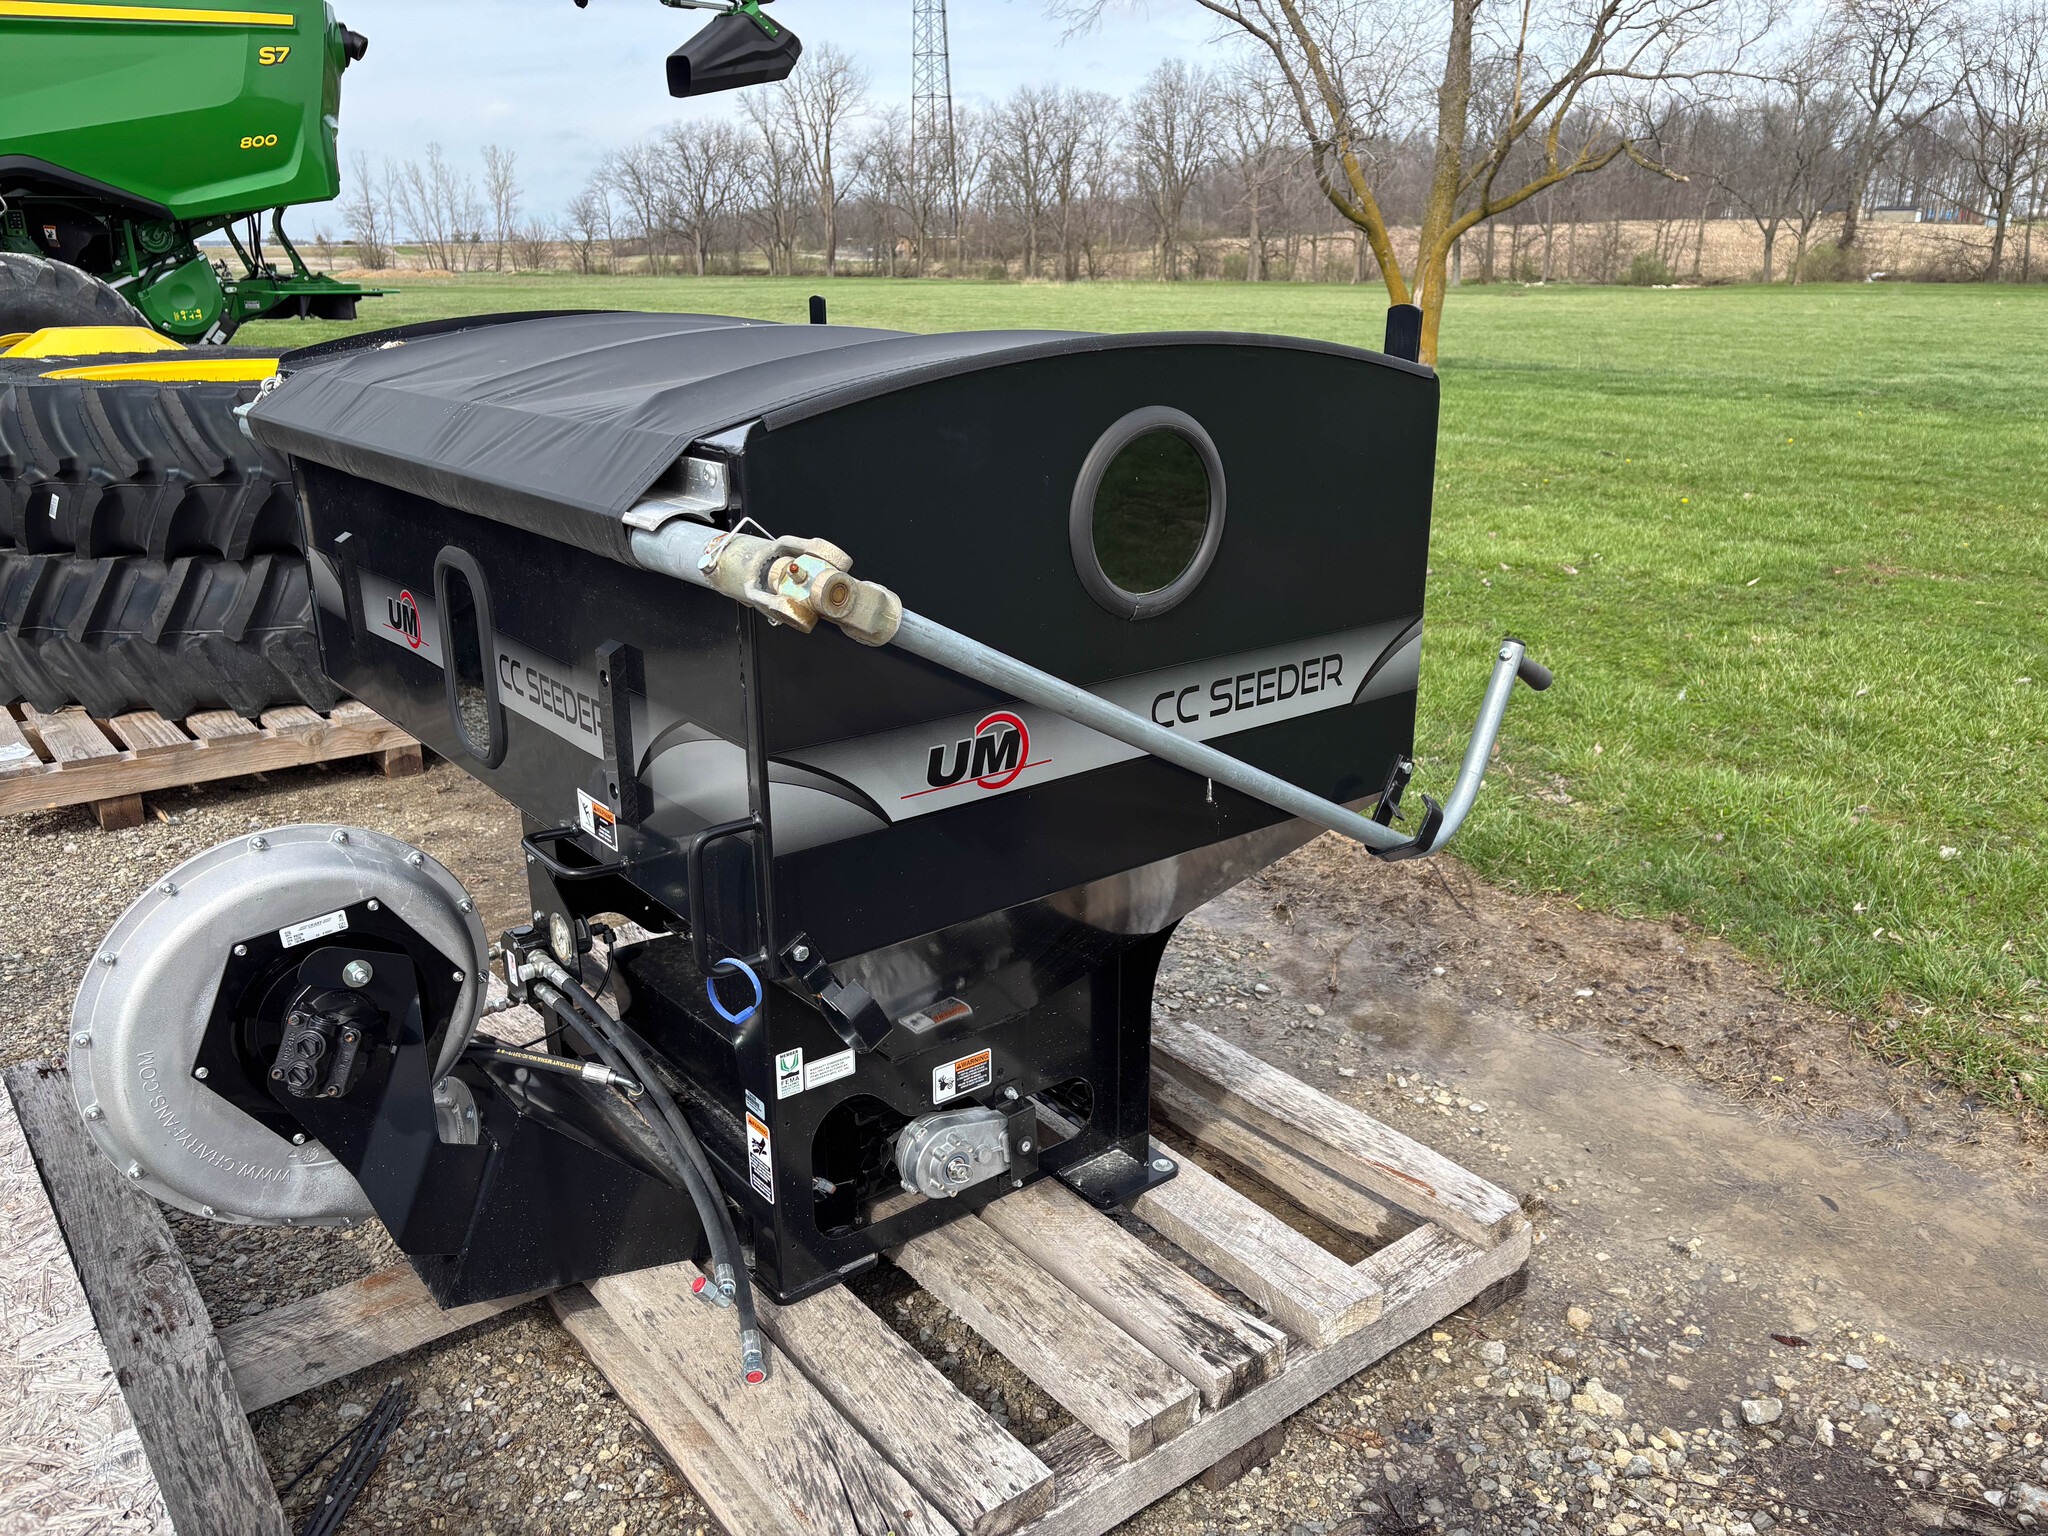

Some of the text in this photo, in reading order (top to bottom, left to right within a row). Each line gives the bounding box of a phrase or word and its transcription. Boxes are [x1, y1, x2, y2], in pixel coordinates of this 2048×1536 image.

[258, 46, 291, 66] S7
[239, 134, 278, 150] 800
[386, 596, 419, 638] UM
[499, 653, 525, 696] CC
[1151, 653, 1343, 728] CC SEEDER
[926, 727, 1021, 788] UM
[780, 1049, 799, 1059] MEMBER
[961, 1053, 989, 1067] WARNING
[552, 1060, 582, 1071] RESISTANT
[780, 1075, 800, 1087] FEMA
[137, 1050, 291, 1183] WWW.CRARYFANS.COM
